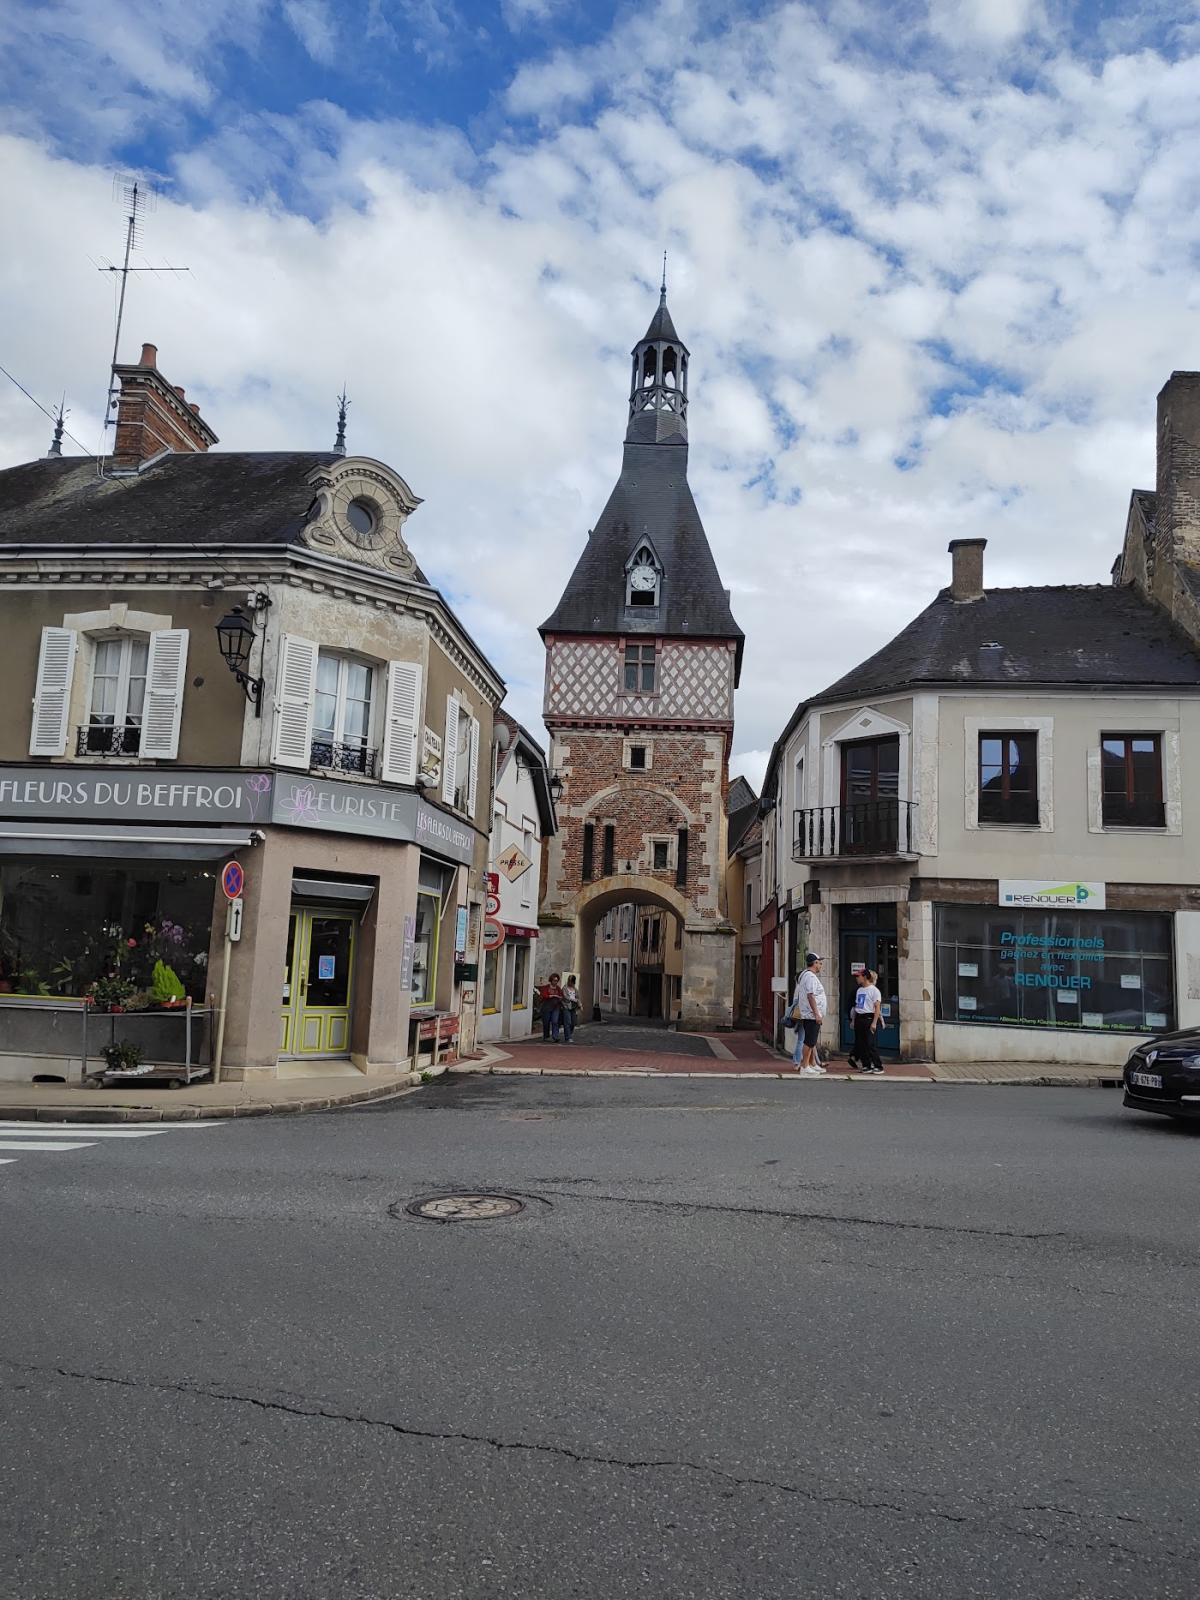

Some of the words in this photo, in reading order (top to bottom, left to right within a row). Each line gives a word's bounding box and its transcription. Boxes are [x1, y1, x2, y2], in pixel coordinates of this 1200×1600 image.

[0, 780, 88, 804] FLEURS
[94, 783, 131, 806] DU
[137, 784, 242, 809] BEFFROI
[294, 788, 401, 822] FLEURISTE
[416, 810, 427, 831] LES
[500, 859, 525, 867] PRESSE
[1013, 894, 1076, 904] RENOUER
[1000, 931, 1105, 949] Professionnels
[1000, 950, 1040, 961] gagnez
[1041, 951, 1055, 960] en
[1040, 963, 1065, 972] avec
[1014, 972, 1092, 989] RENOUER
